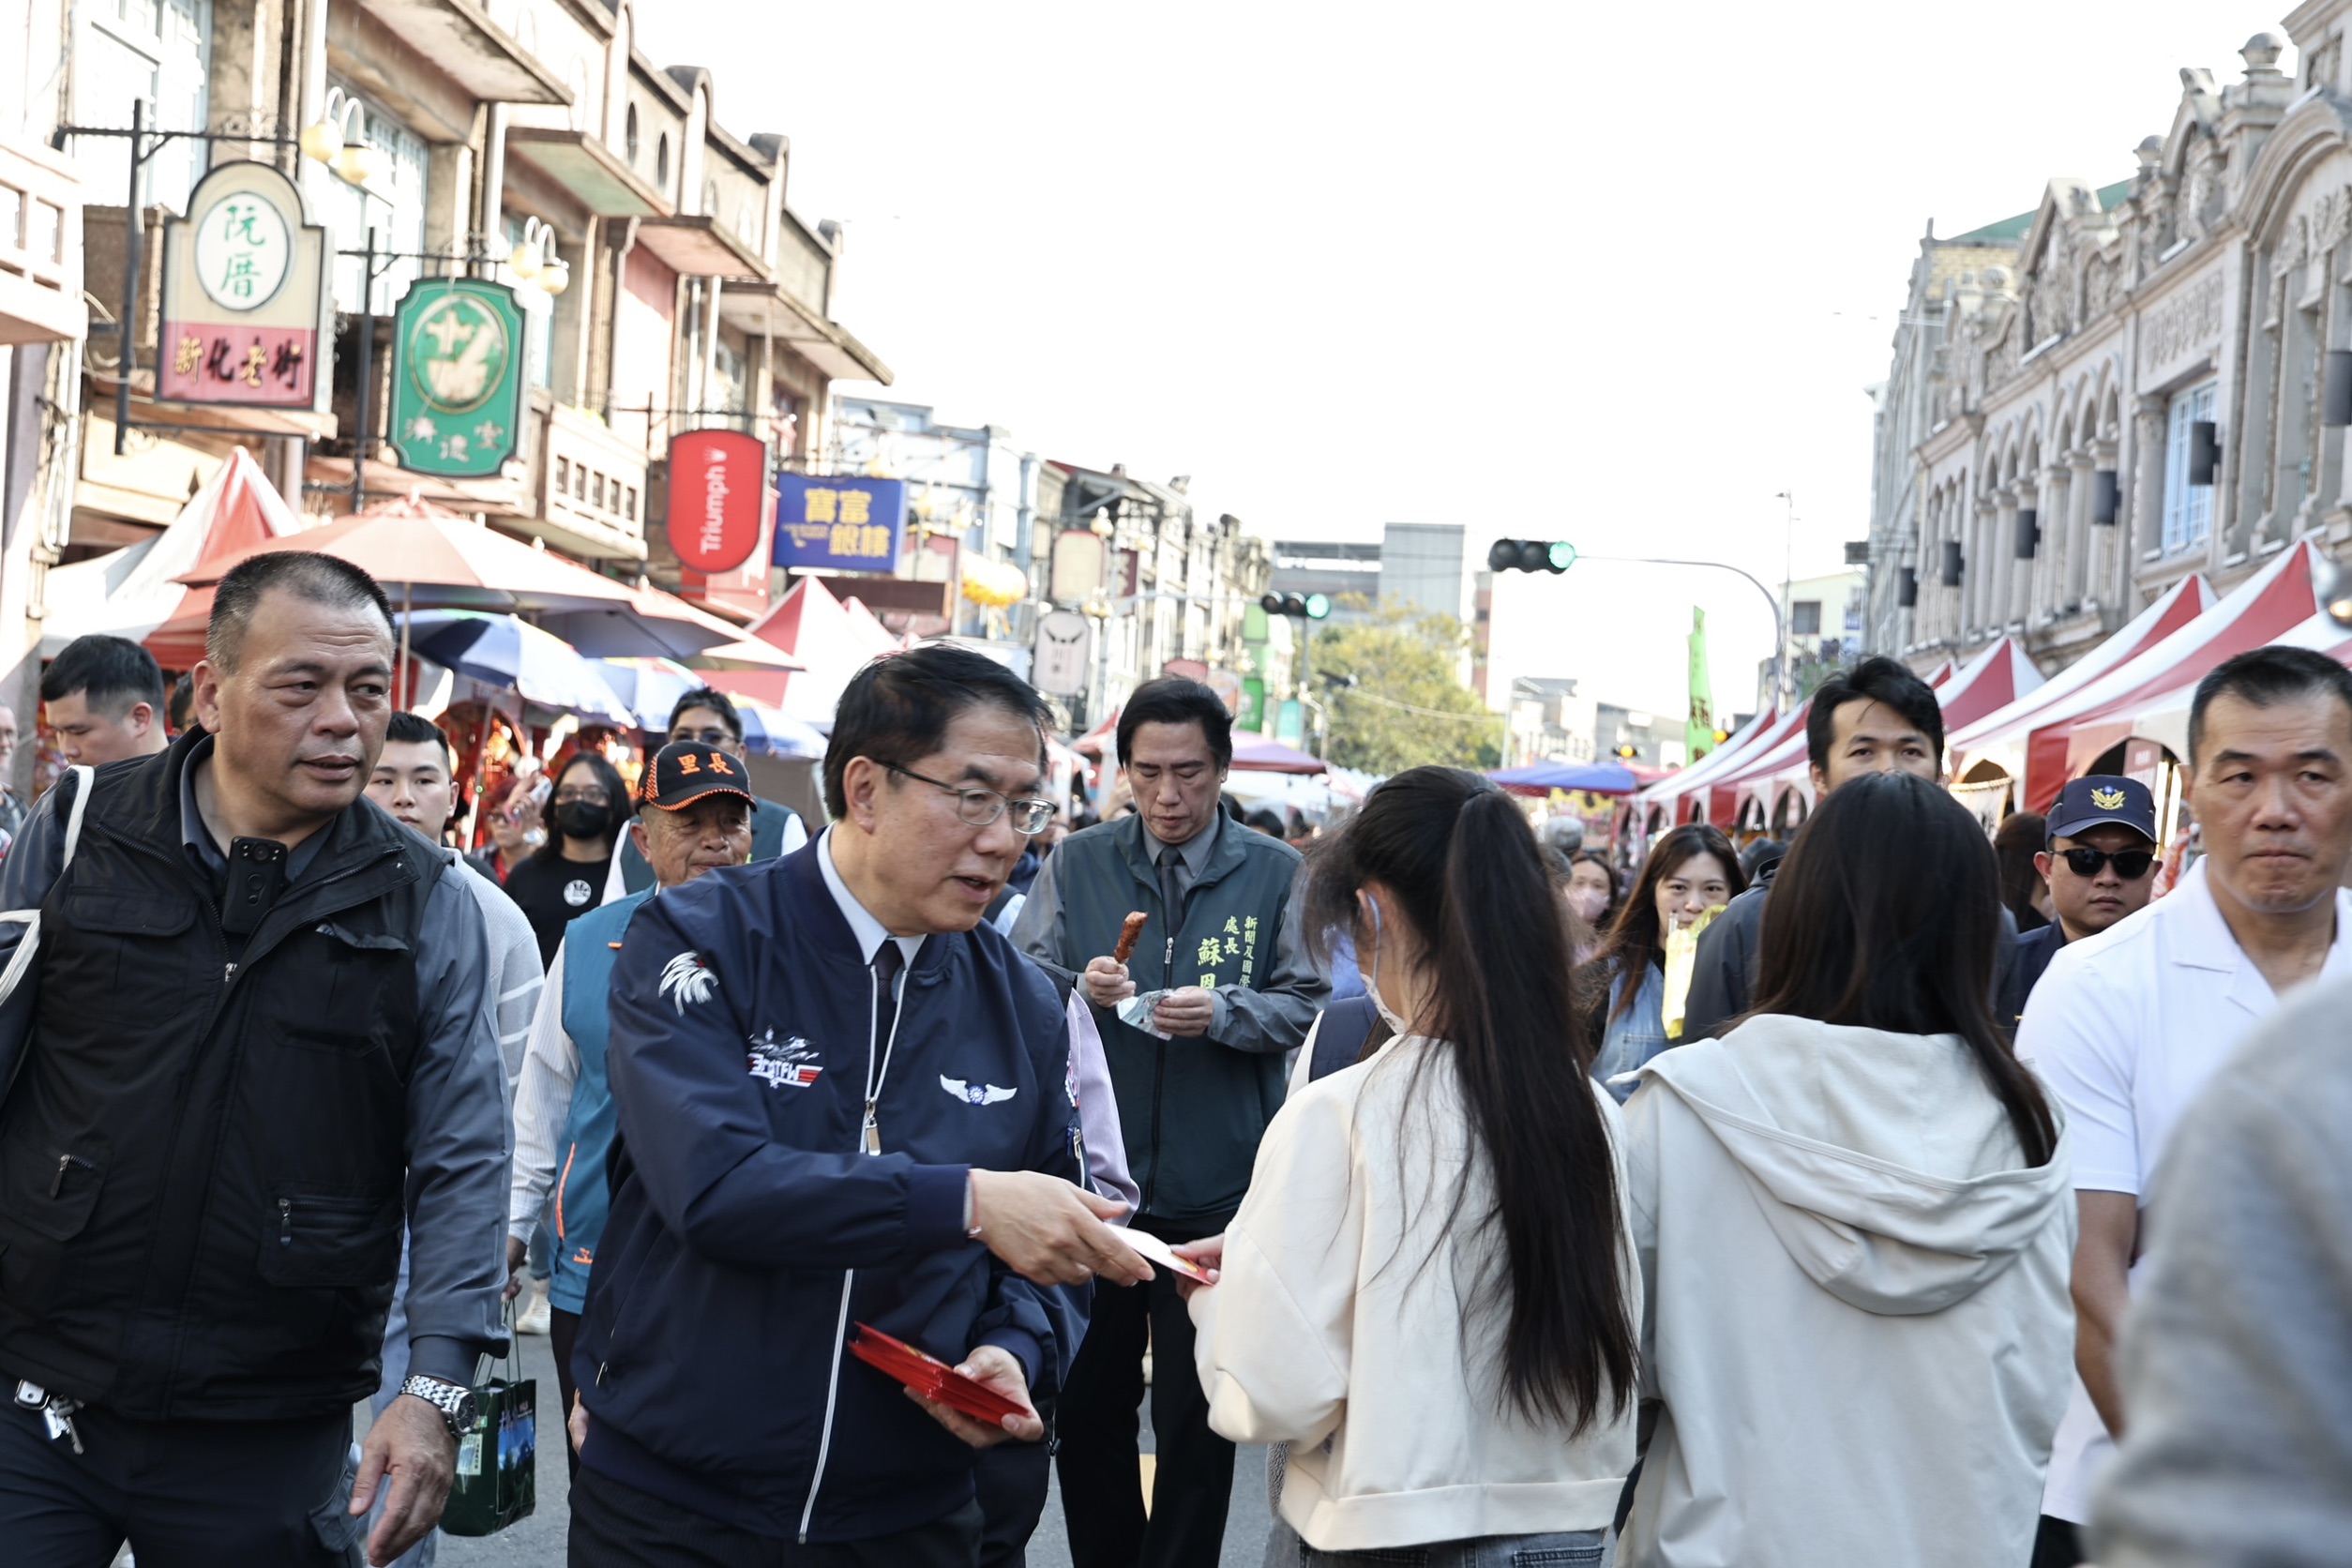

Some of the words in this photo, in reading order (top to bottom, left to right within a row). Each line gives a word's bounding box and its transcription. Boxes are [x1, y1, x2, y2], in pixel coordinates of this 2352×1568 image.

[220, 205, 265, 297] 阮厝
[174, 336, 303, 389] 新化老街
[700, 465, 730, 555] Triumph
[678, 752, 734, 776] 里長
[1223, 915, 1240, 954] 處長
